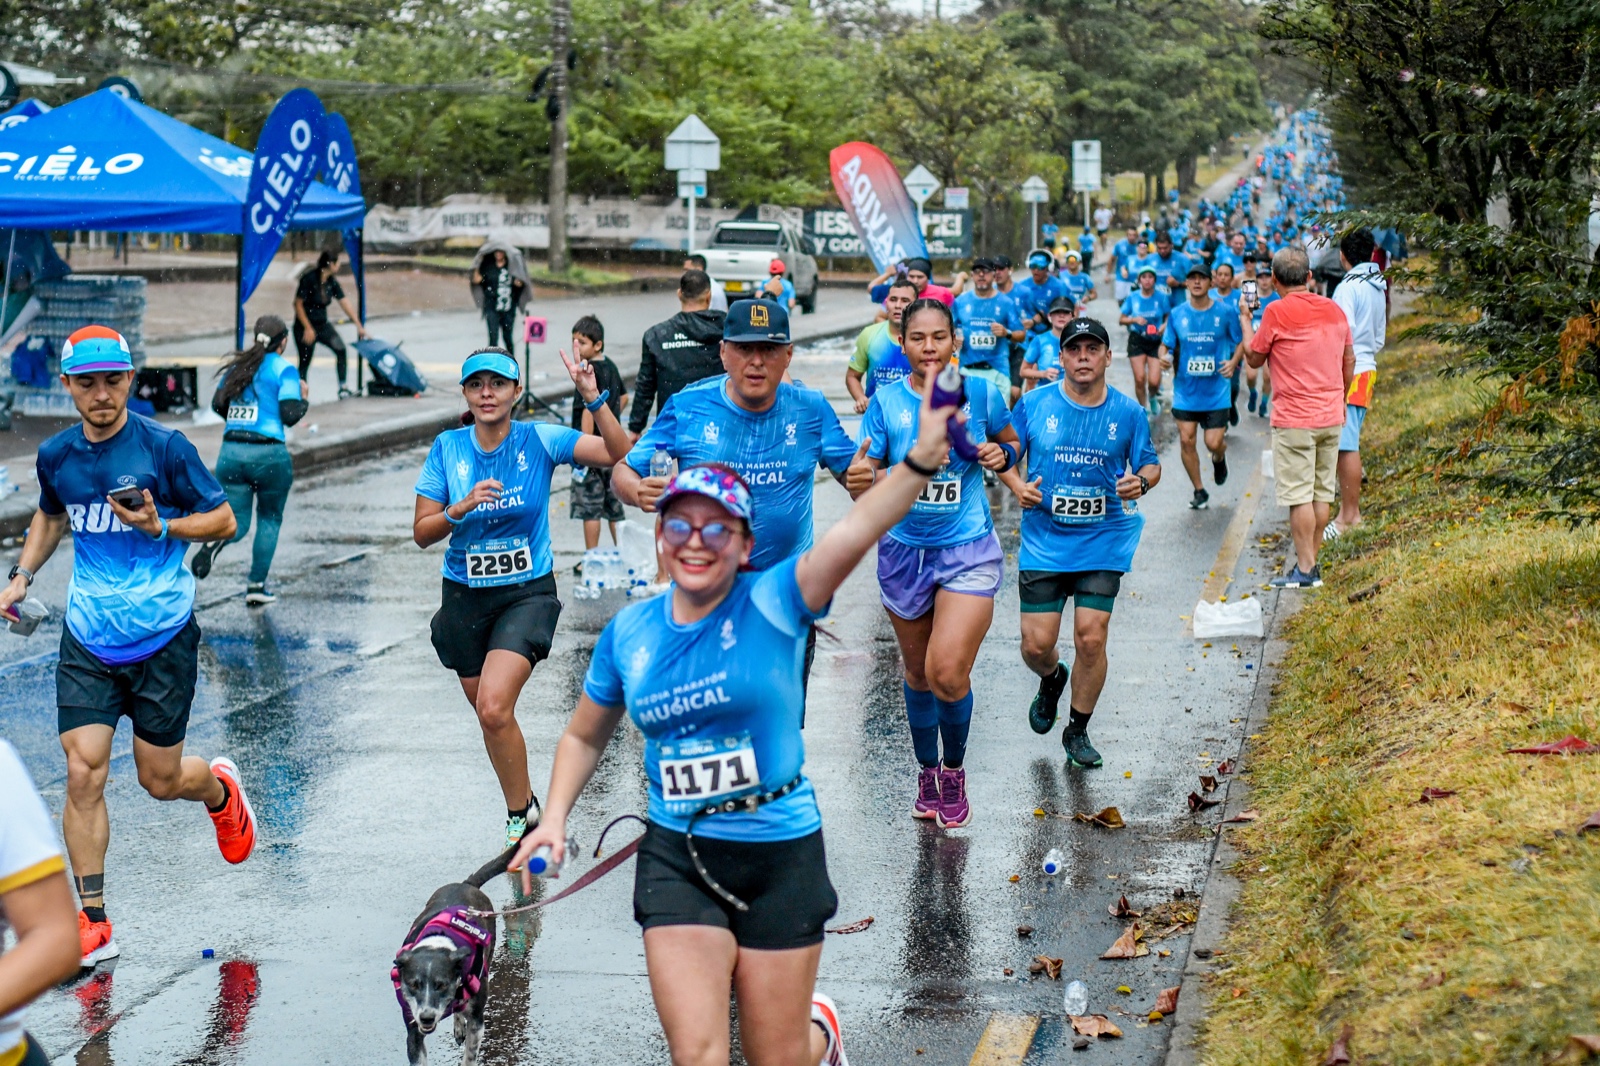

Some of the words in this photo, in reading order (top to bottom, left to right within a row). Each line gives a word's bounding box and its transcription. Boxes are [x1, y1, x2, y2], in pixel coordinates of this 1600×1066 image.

[442, 212, 489, 227] PAREDES
[971, 336, 996, 346] 1643
[1189, 362, 1214, 371] 2274
[228, 407, 255, 419] 2227
[746, 460, 788, 470] MARATÓN
[918, 482, 957, 503] 176
[1054, 497, 1103, 516] 2293
[470, 550, 528, 578] 2296
[664, 754, 751, 797] 1171
